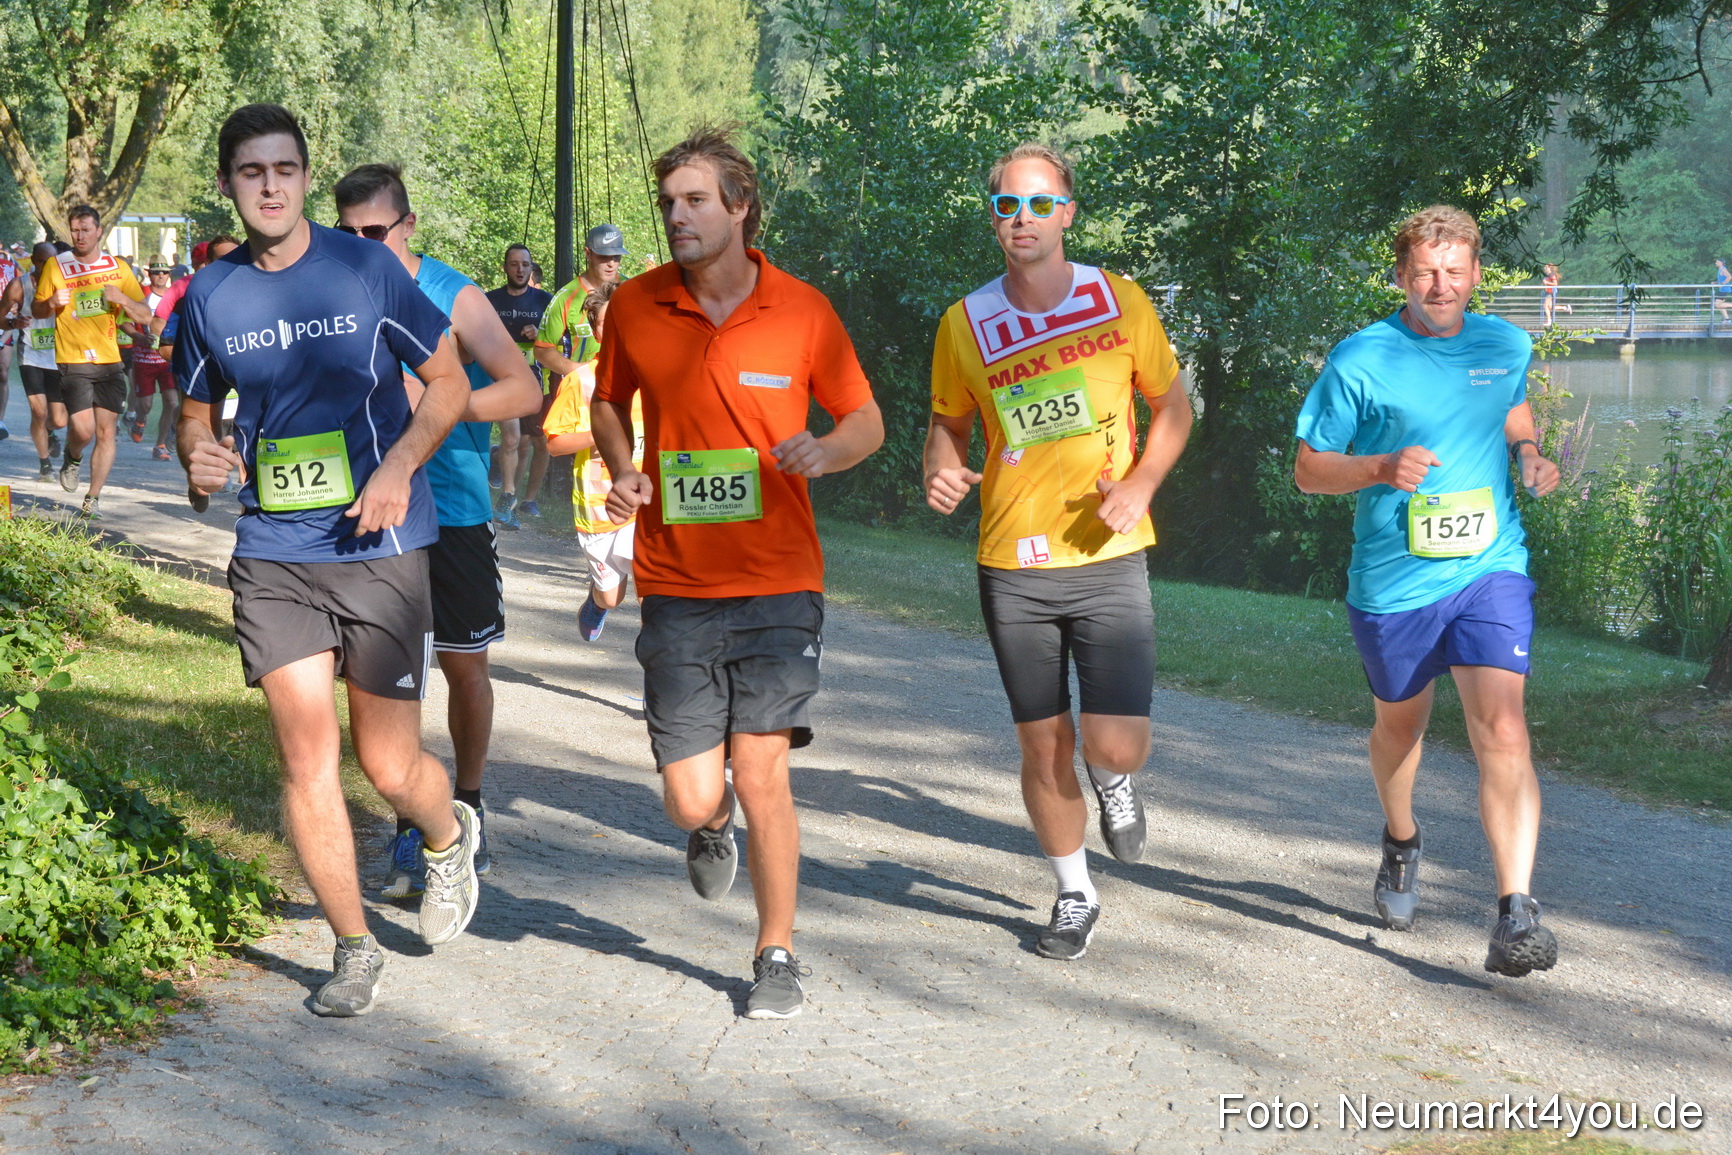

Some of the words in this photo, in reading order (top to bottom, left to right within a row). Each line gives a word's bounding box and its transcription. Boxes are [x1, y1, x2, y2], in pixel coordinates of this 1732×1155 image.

[65, 279, 92, 290] MAX
[94, 272, 122, 284] BÖGL
[497, 309, 512, 317] URO
[518, 311, 538, 319] POLES
[38, 334, 56, 345] 872
[225, 329, 276, 356] EURO
[295, 314, 358, 341] POLES
[987, 353, 1053, 390] MAX
[1057, 329, 1129, 366] BÖGL
[1011, 393, 1080, 430] 1235
[1053, 418, 1076, 429] Daniel
[272, 461, 328, 490] 512
[273, 491, 296, 499] Harrer
[297, 487, 334, 497] Johannes
[673, 475, 747, 503] 1485
[709, 503, 743, 511] Christian
[1420, 512, 1485, 539] 1527
[1428, 539, 1460, 547] Seemann
[470, 621, 497, 640] hummel
[396, 681, 415, 689] adidas
